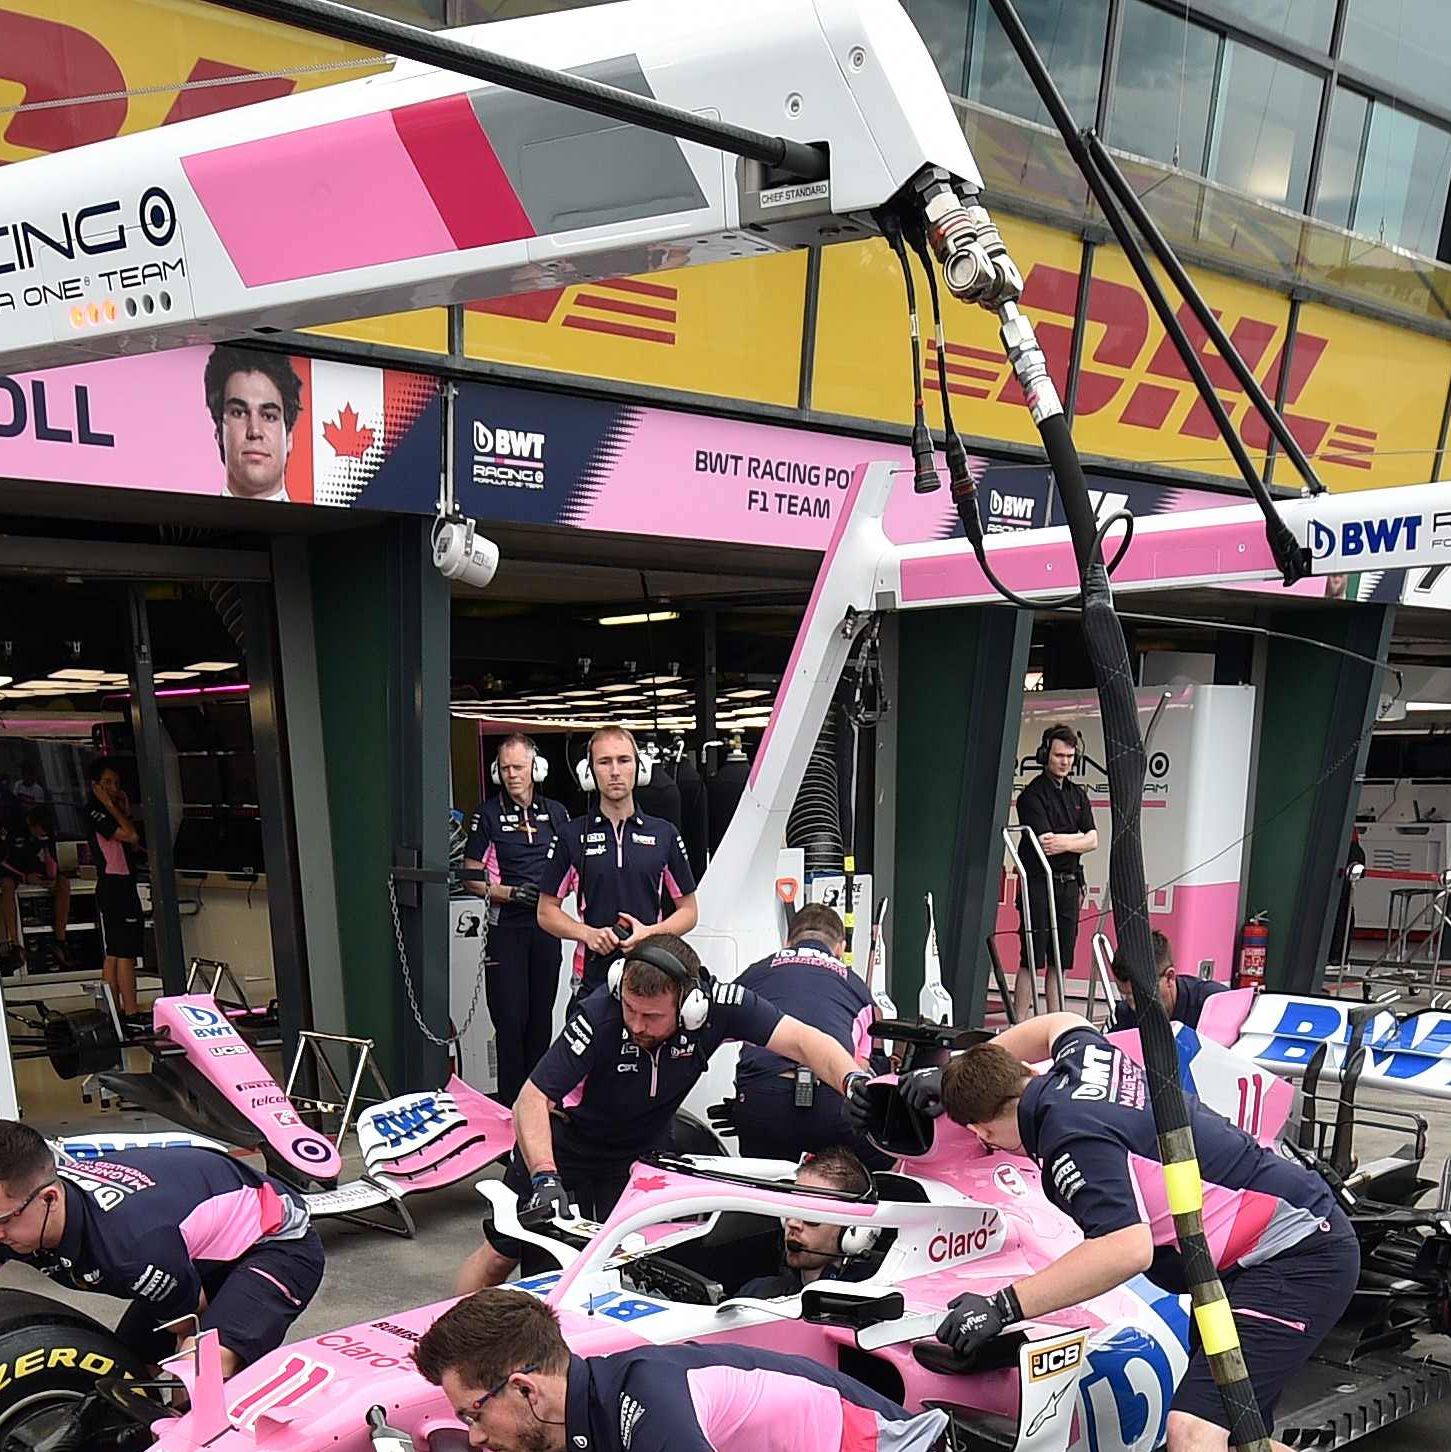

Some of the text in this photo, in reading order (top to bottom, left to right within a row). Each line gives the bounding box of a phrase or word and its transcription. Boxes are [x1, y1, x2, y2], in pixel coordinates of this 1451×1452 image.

[761, 184, 828, 203] CHIEF STANDARD
[98, 258, 186, 292] TEAM
[998, 263, 1331, 457] DHL
[496, 429, 545, 459] BWT
[474, 465, 535, 482] RACING
[695, 450, 742, 476] BWT
[748, 457, 821, 486] RACING
[747, 490, 831, 519] F1 TEAM
[1003, 496, 1035, 518] BWT
[1341, 515, 1422, 557] BWT
[194, 1026, 234, 1038] BWT
[1237, 1073, 1264, 1136] 11
[928, 1226, 990, 1264] Claro
[1037, 1341, 1082, 1374] JCB
[228, 1353, 335, 1430] 11
